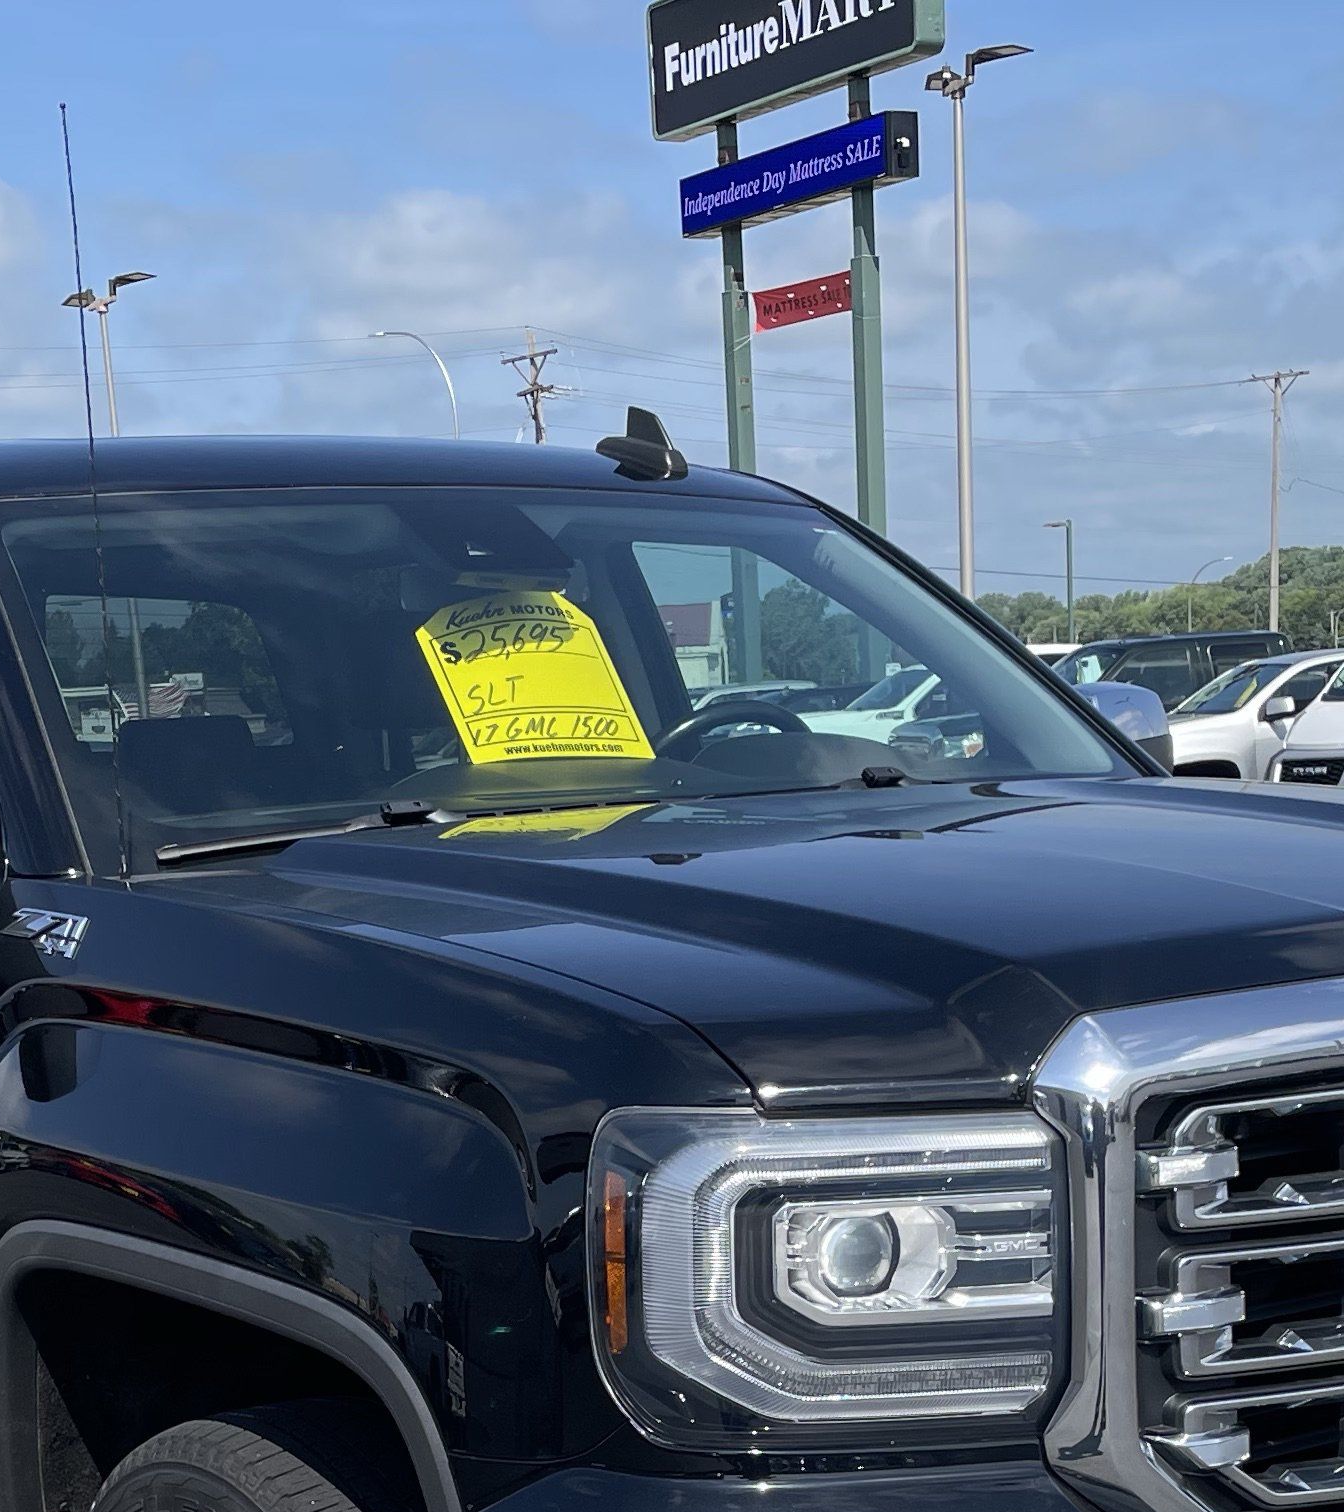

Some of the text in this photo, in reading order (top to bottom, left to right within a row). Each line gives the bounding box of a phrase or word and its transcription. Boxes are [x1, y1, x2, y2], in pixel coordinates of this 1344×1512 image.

[663, 0, 895, 92] FurnitureMA
[684, 135, 881, 217] Independence Day Mattress SALE
[763, 295, 818, 317] MATTRESS
[446, 601, 574, 630] Kuehn MOTORS
[467, 675, 524, 714] SLT
[571, 714, 619, 738] 1500
[505, 742, 624, 755] www.kuehnmotors.com
[994, 1239, 1038, 1253] GMC
